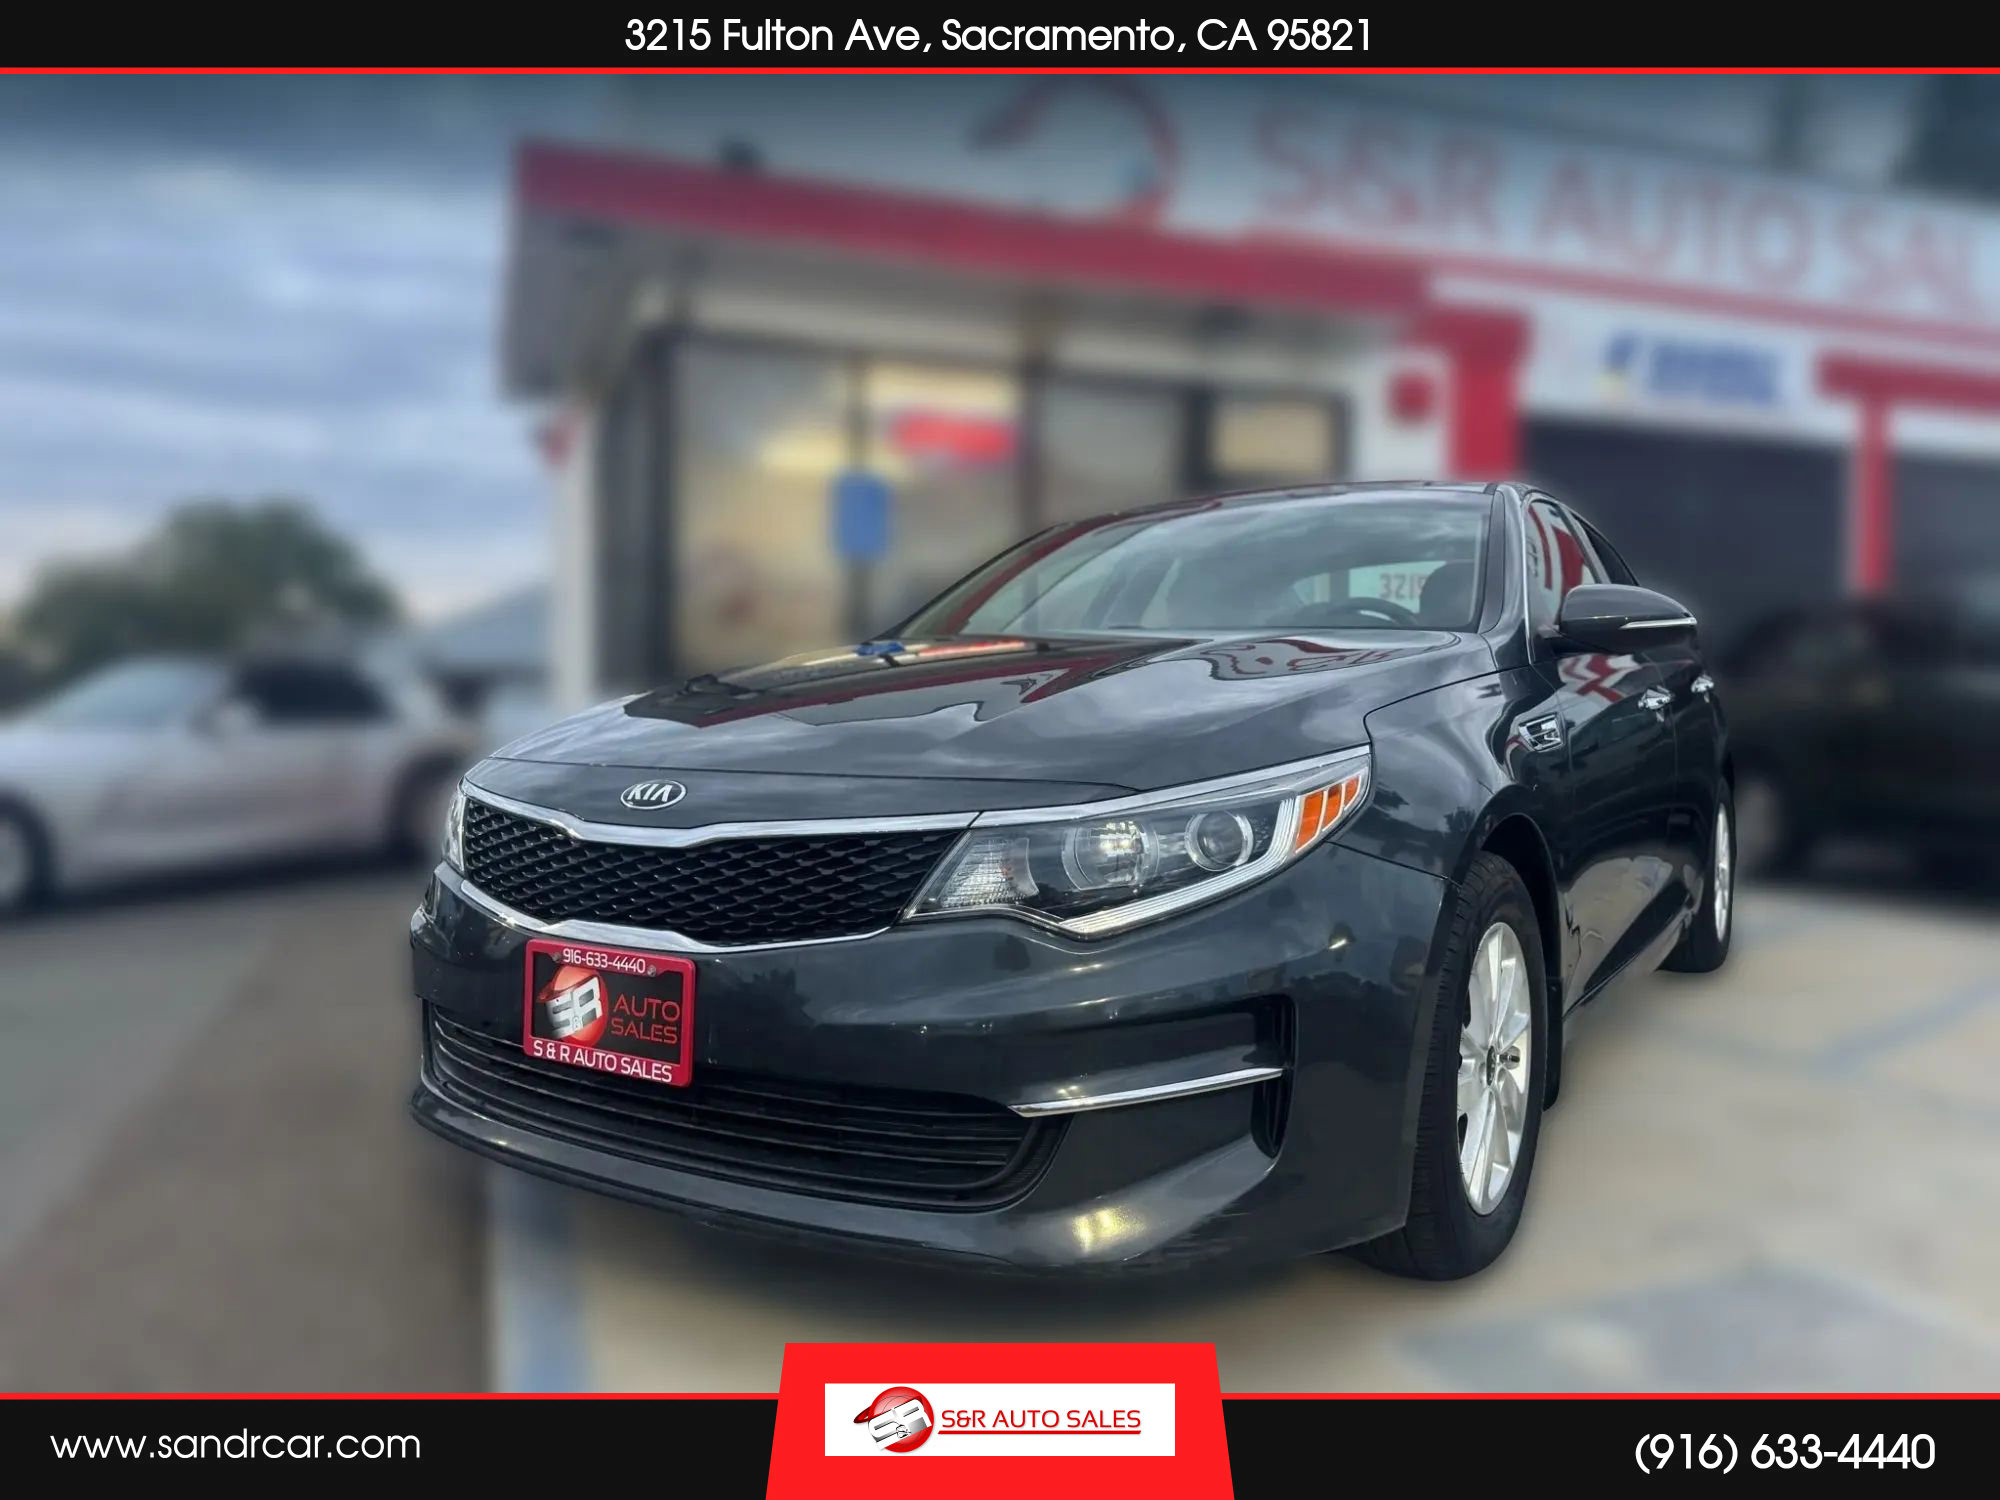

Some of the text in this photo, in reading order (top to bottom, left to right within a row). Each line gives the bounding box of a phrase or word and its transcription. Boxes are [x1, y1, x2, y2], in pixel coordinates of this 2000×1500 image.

[626, 783, 673, 802] KIA
[563, 948, 646, 973] 916-633-4440
[613, 994, 681, 1021] AUTO
[611, 1018, 678, 1045] SALES
[533, 1040, 673, 1083] S & R AUTO SALES
